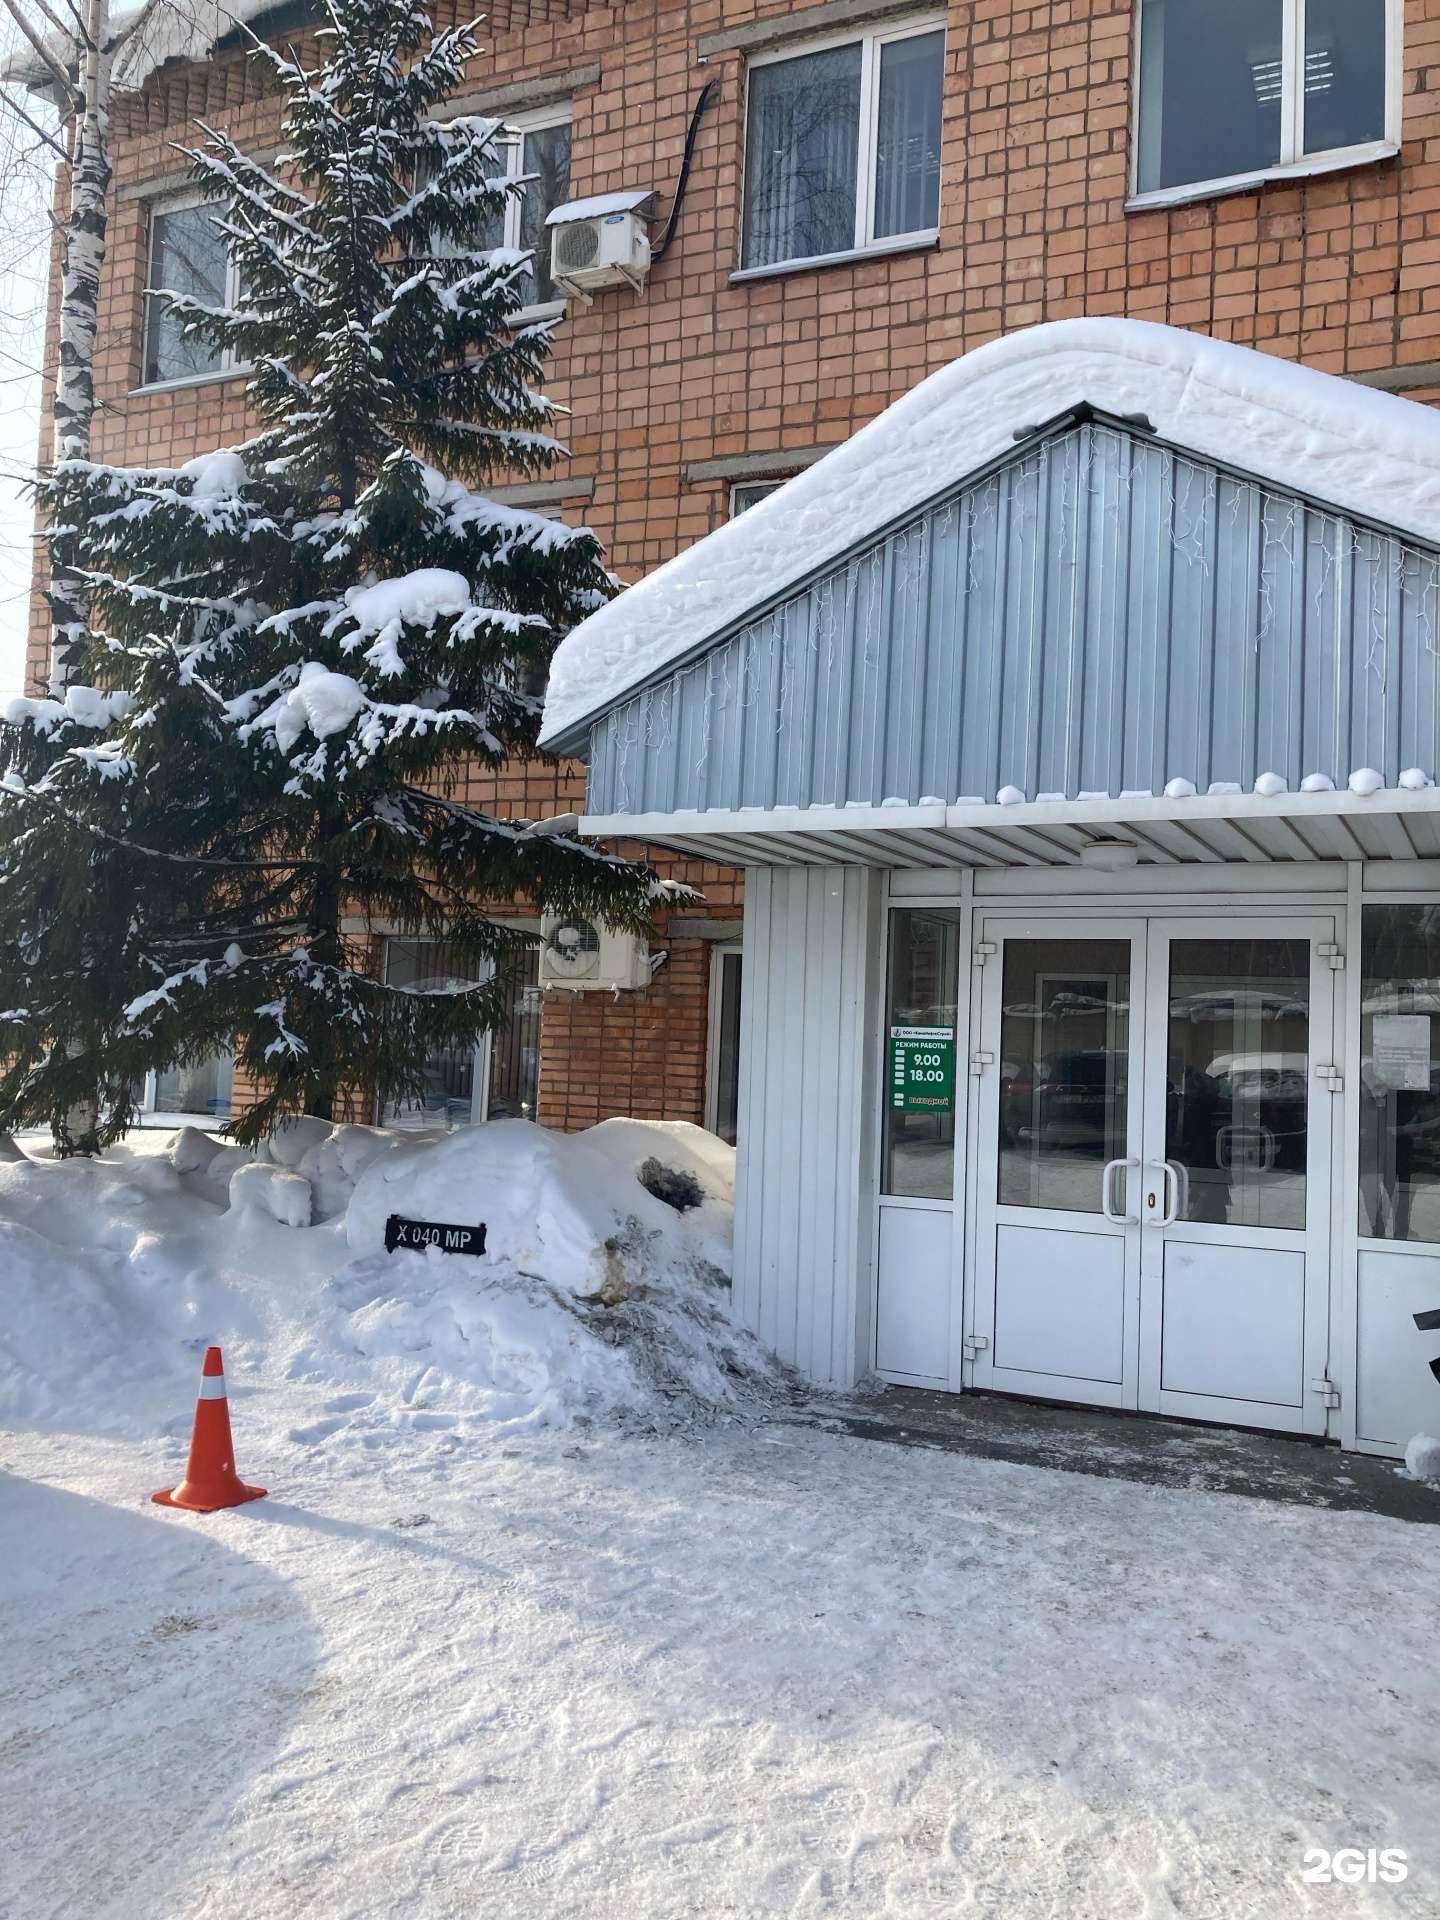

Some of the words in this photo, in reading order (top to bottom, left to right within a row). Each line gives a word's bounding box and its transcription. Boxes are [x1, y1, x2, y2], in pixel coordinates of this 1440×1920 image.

[913, 1054, 941, 1066] 9.00
[910, 1069, 944, 1082] 18.00
[412, 1227, 440, 1245] 040
